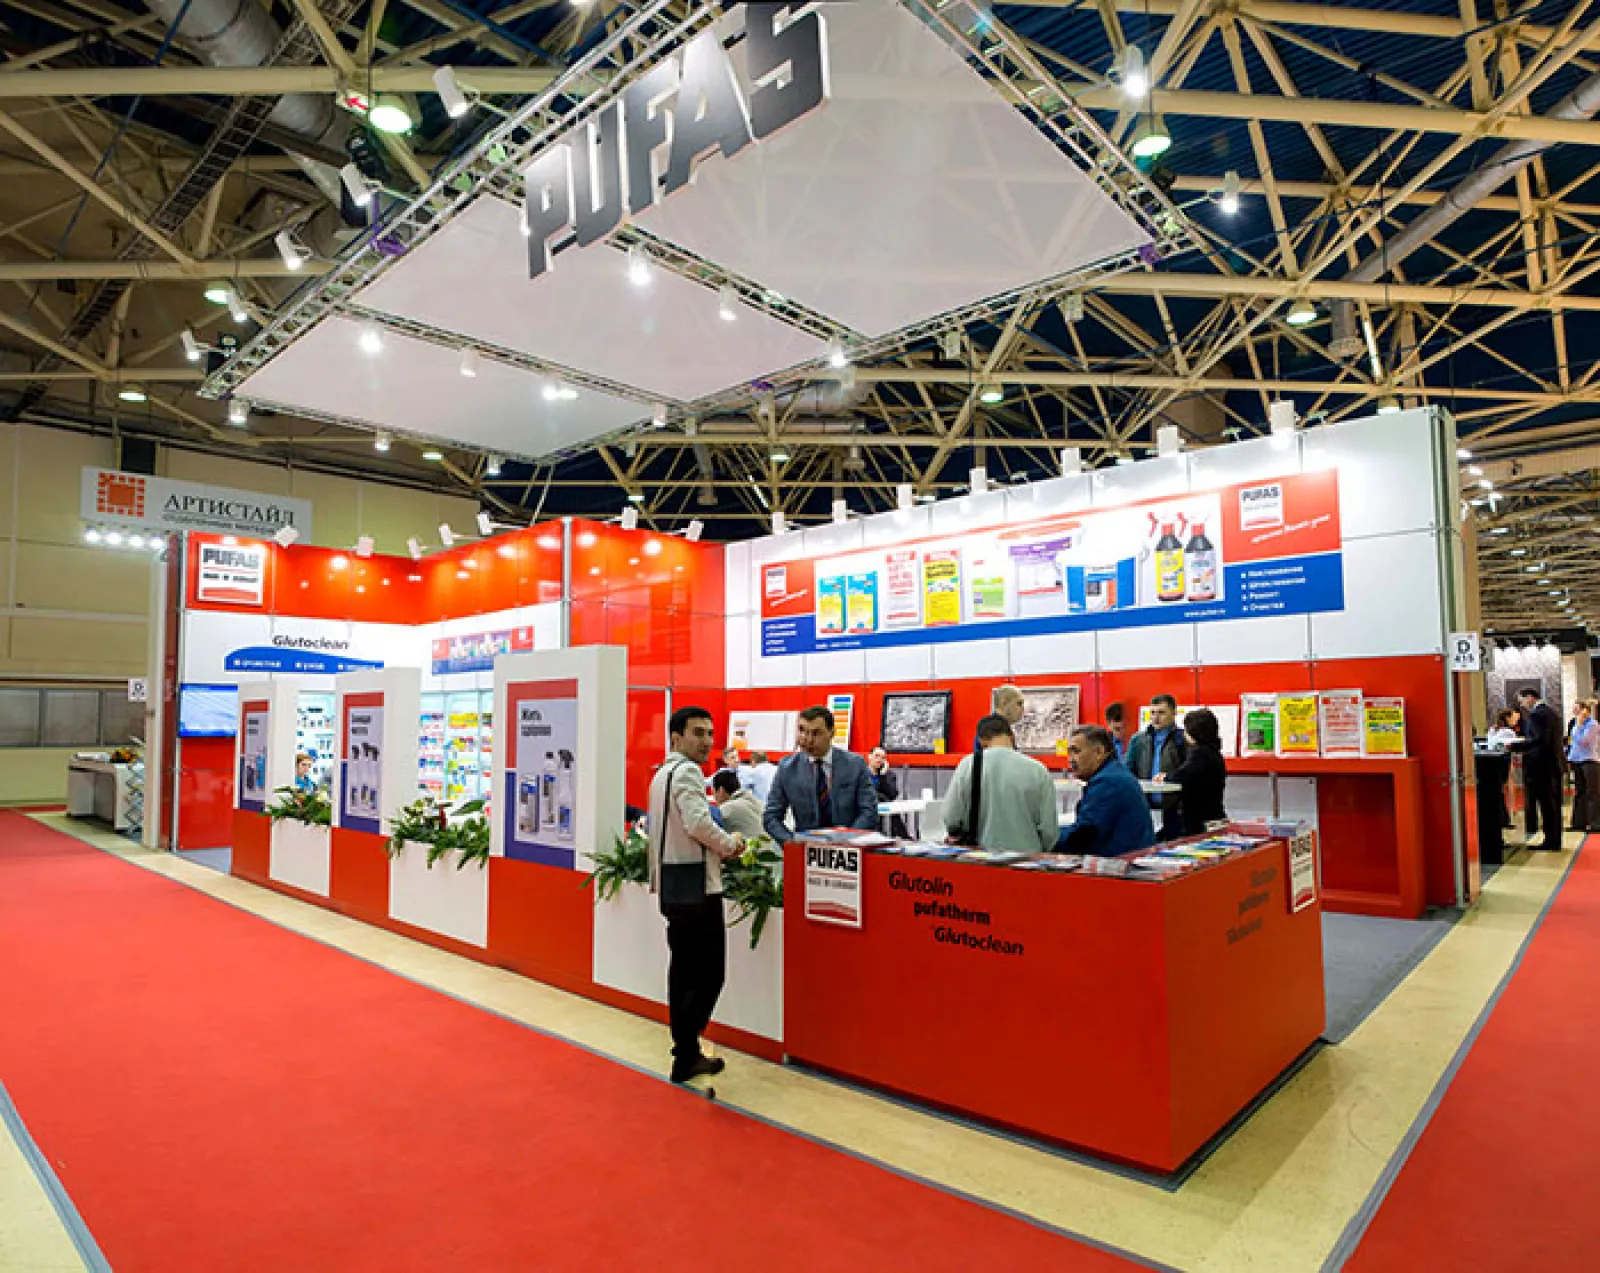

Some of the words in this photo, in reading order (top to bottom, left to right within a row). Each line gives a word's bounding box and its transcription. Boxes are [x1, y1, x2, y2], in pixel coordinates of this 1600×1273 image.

[525, 1, 831, 280] PUFAS
[163, 493, 296, 527] АРТИСТАЙЛ
[203, 548, 259, 570] PUFAS
[272, 634, 349, 650] Glutoclean
[1458, 639, 1470, 653] D
[807, 846, 858, 872] PUFAS
[888, 870, 954, 897] Glutolin
[913, 900, 991, 925] pufatherm
[934, 926, 1025, 956] Glutoclean
